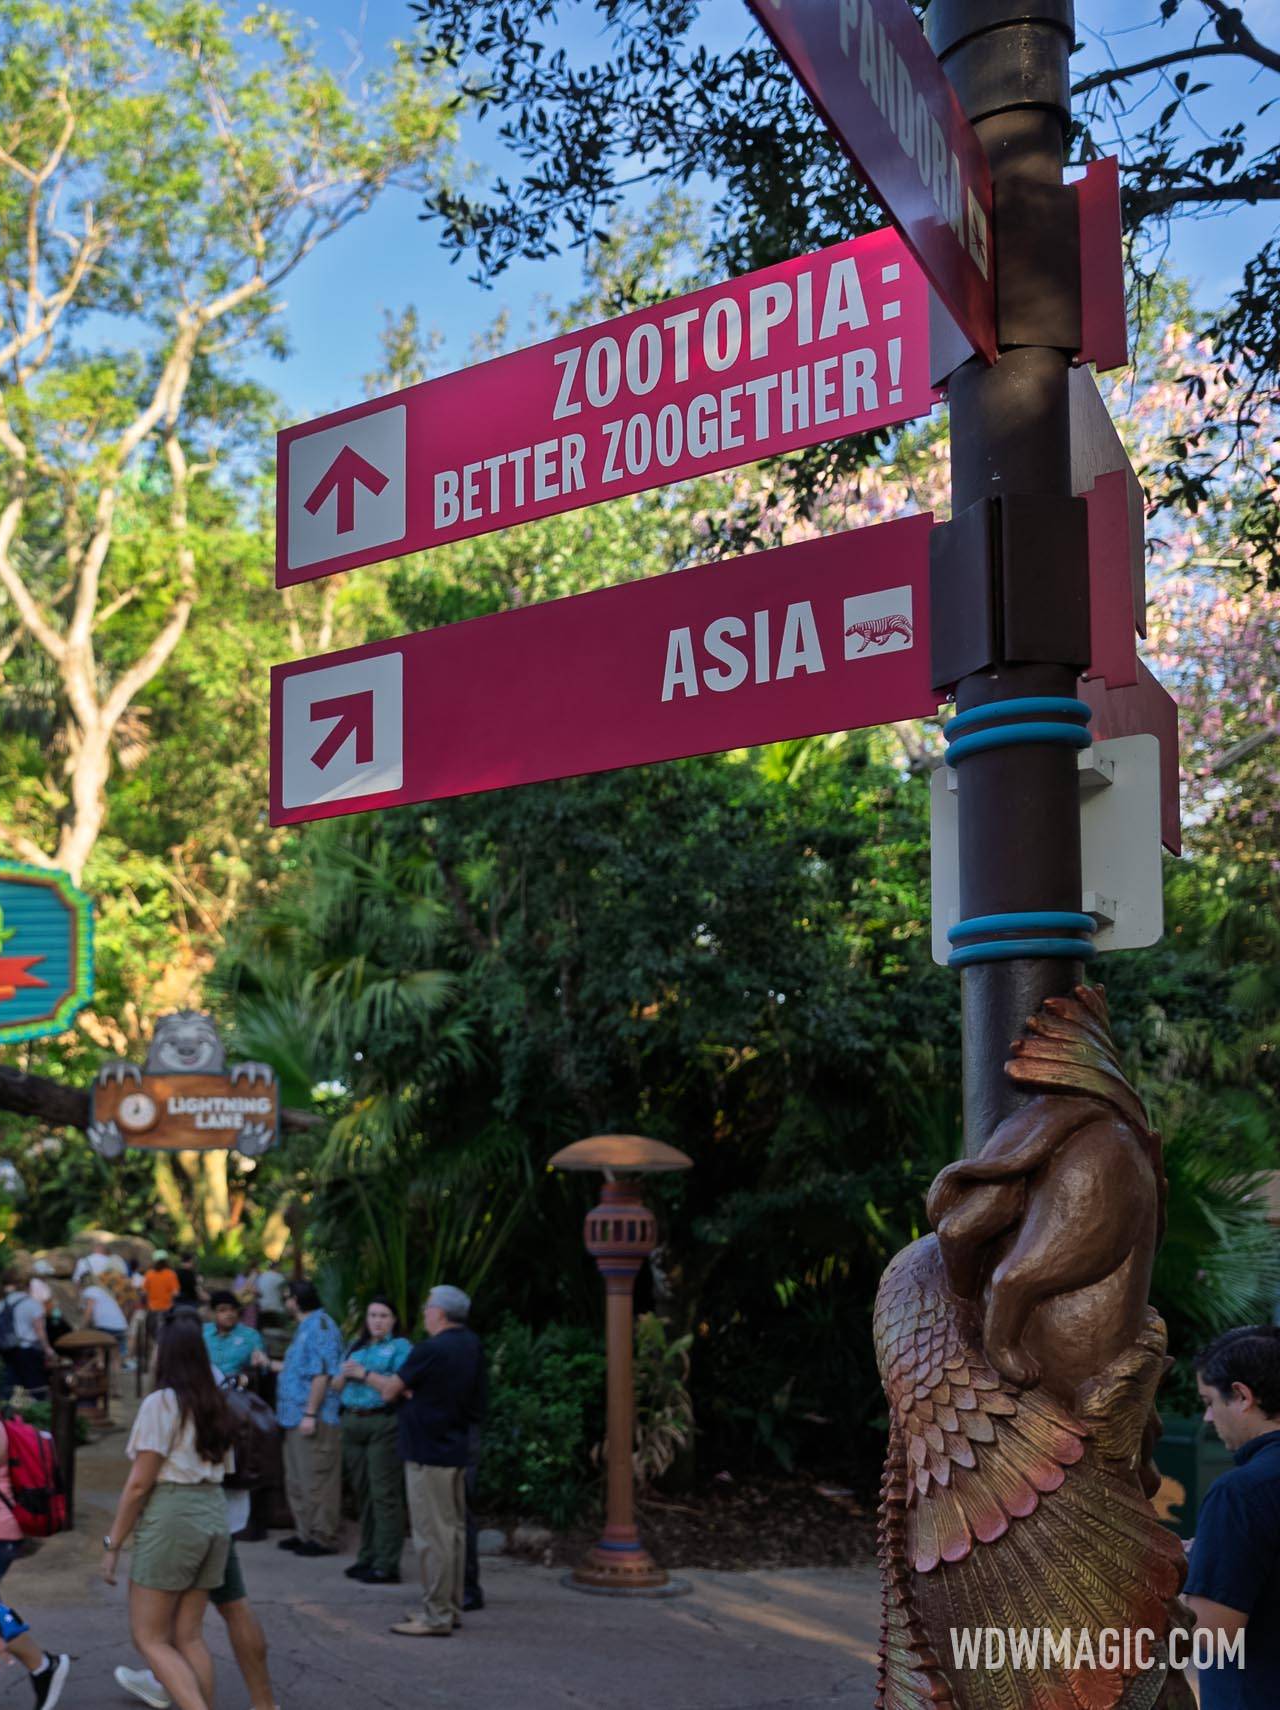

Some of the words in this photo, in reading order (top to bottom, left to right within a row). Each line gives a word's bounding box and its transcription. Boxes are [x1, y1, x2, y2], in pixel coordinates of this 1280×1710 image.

[838, 0, 965, 249] PANDORA
[553, 257, 901, 420] ZOOTOPIA:
[434, 434, 586, 529] BETTER
[601, 337, 903, 484] ZOOGETHER!
[661, 601, 826, 702] ASIA
[168, 1096, 272, 1114] LIGHTNING
[195, 1114, 244, 1130] LANE
